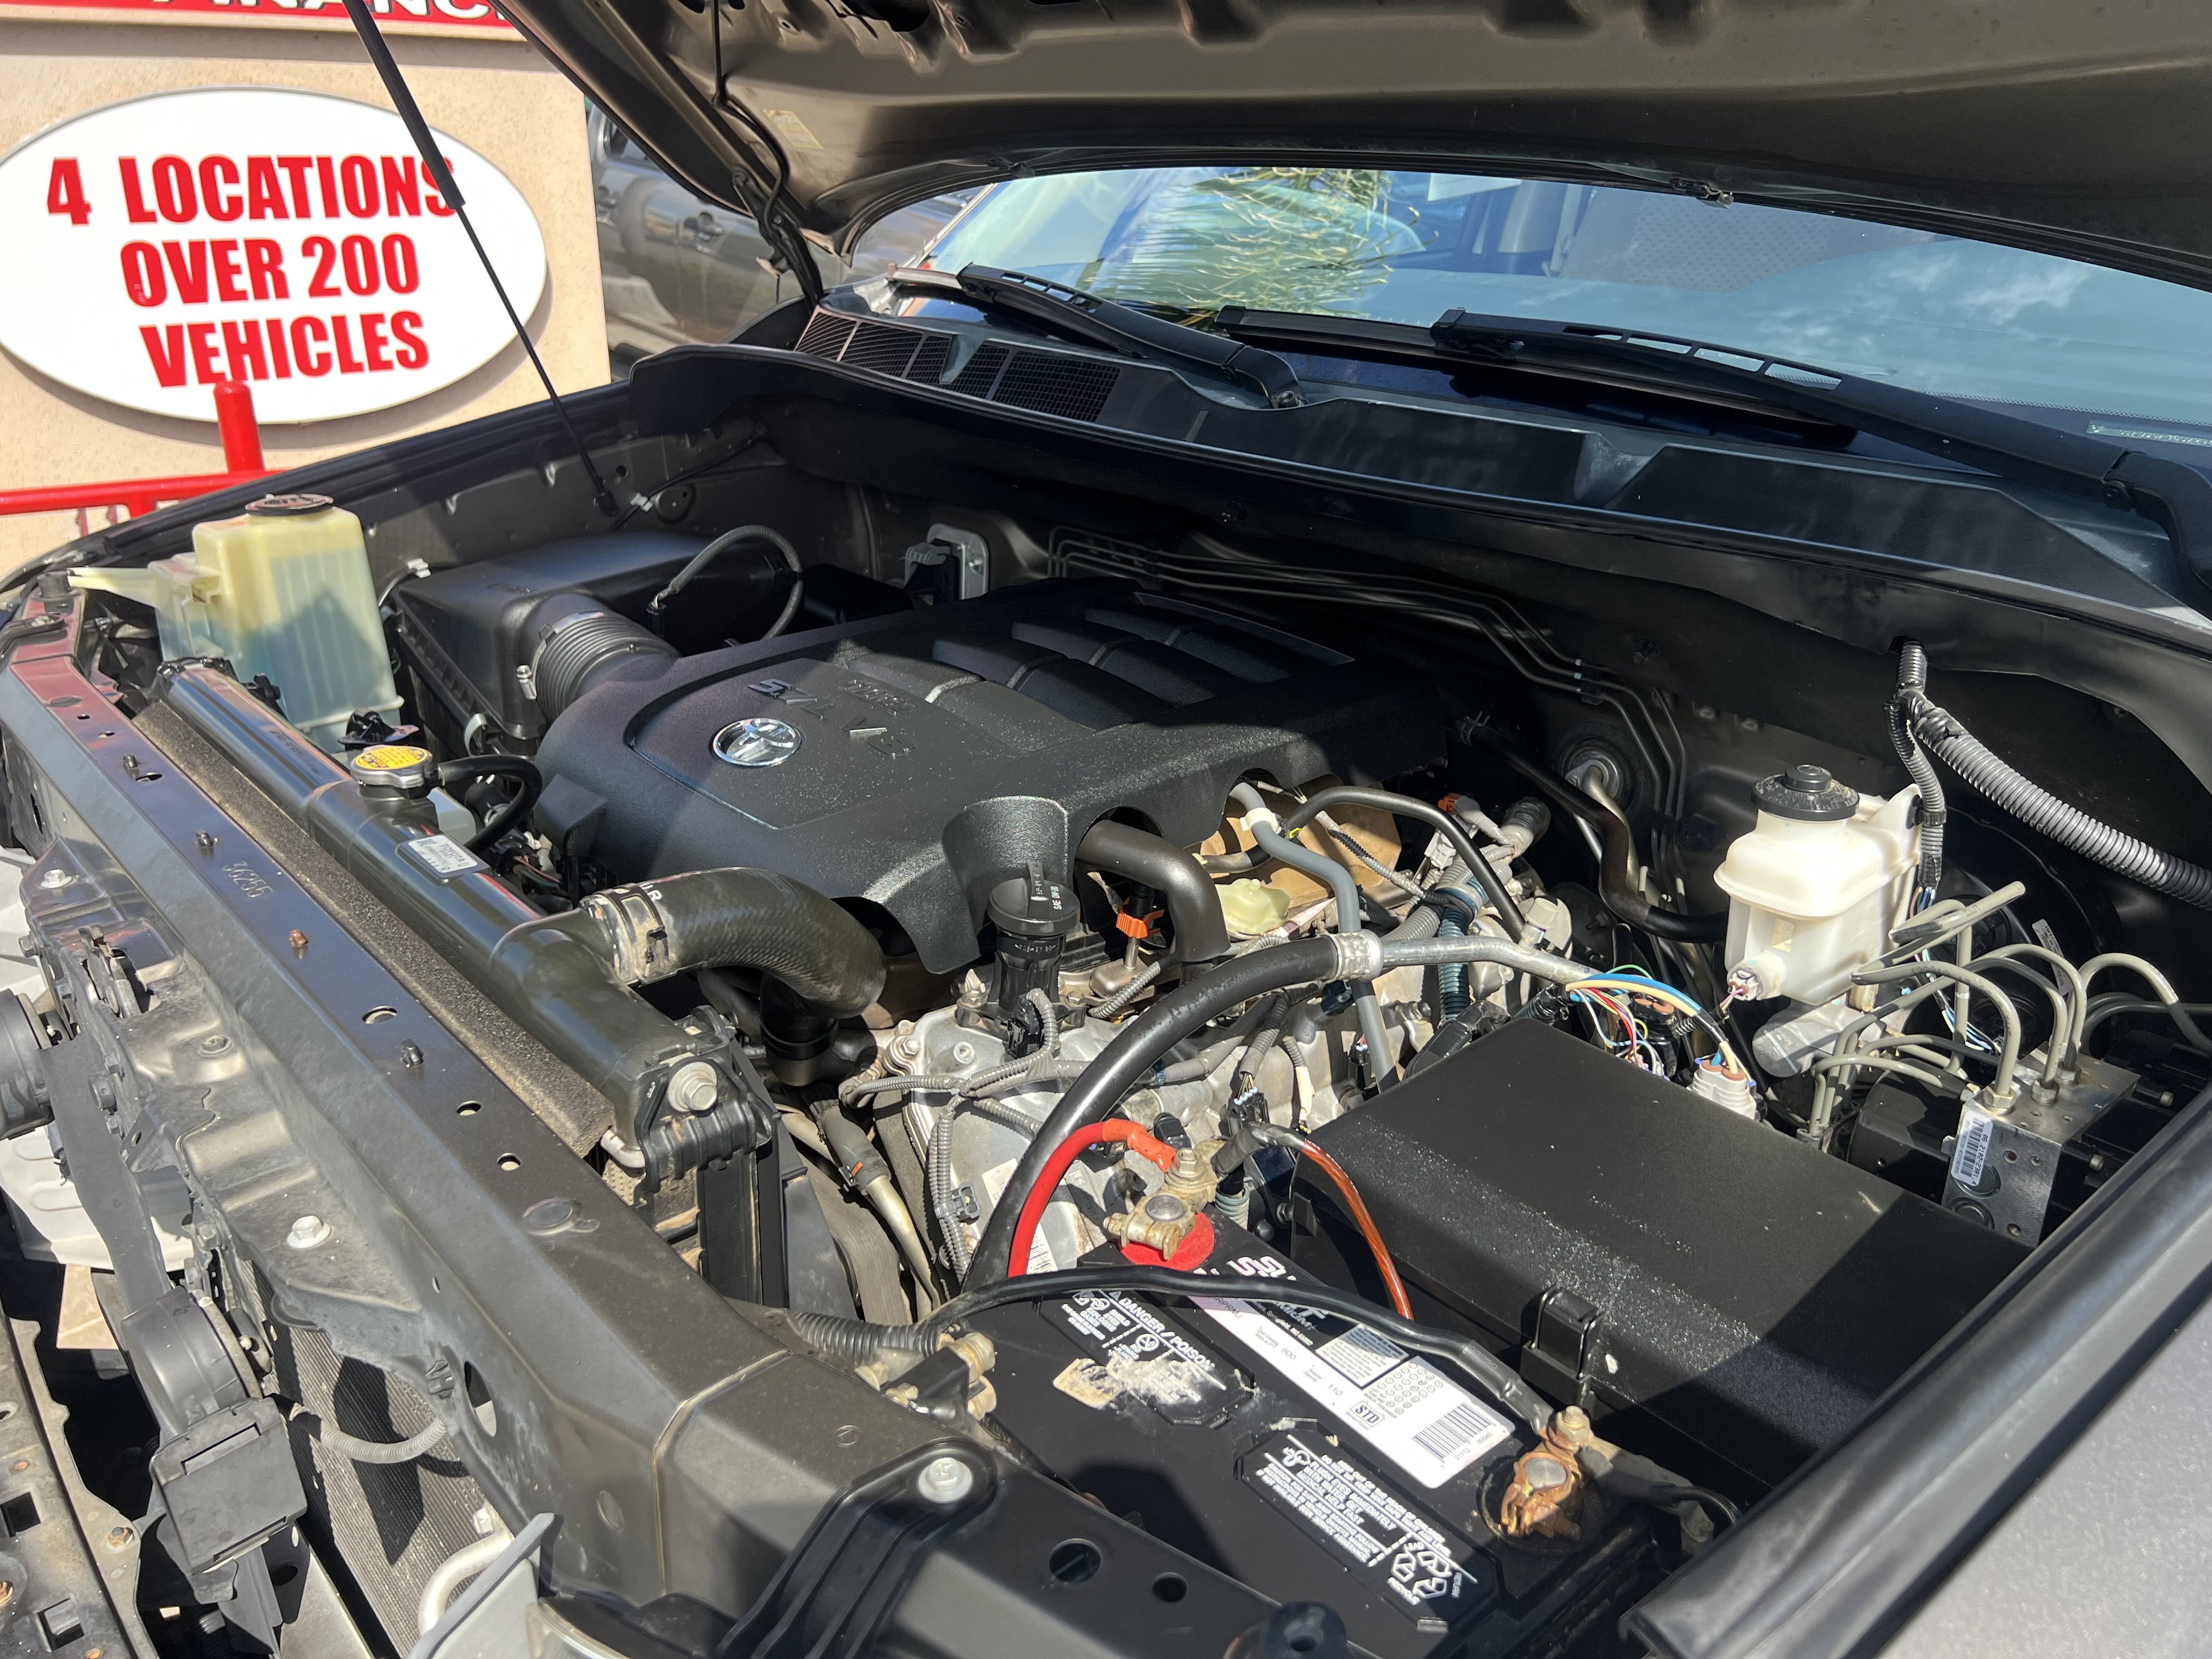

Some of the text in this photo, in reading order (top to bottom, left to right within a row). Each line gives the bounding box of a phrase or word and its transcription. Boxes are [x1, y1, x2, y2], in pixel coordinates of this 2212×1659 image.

[46, 155, 458, 226] 4 LOCATIONS
[120, 233, 420, 307] OVER 200
[139, 311, 430, 388] VEHICLES
[1080, 1310, 1101, 1327] GASES
[1086, 1307, 1117, 1331] EXPLOSIVE
[1103, 1313, 1120, 1326] EYES
[1109, 1309, 1131, 1327] SHIELD
[1119, 1297, 1166, 1333] DANGER
[1169, 1336, 1216, 1370] POISON
[1129, 1344, 1141, 1352] NO
[1280, 1347, 1296, 1359] 600
[1326, 1383, 1344, 1396] 110
[1354, 1405, 1380, 1424] STD
[1261, 1474, 1276, 1486] NOT
[1272, 1483, 1301, 1506] AVAILABLE
[1297, 1504, 1314, 1517] SEEK
[1311, 1515, 1335, 1535] SERVICE
[1262, 1467, 1300, 1497] INSTRUCTIONS
[1304, 1500, 1328, 1519] VEHICLE
[1295, 1471, 1364, 1525] MEDICAL HELP FAST
[1302, 1466, 1323, 1482] WITH
[1345, 1500, 1363, 1514] GET
[1308, 1462, 1396, 1531] FLUSH EYES IMMEDIATELY
[1320, 1455, 1333, 1464] DO
[1329, 1462, 1345, 1474] NOT
[1353, 1481, 1372, 1494] KEEP
[1369, 1493, 1386, 1506] VENT
[1384, 1504, 1403, 1519] CAPS
[1400, 1517, 1420, 1532] TIGHT
[1417, 1530, 1434, 1542] AND
[1351, 1471, 1366, 1482] OUT
[1373, 1488, 1388, 1499] THE
[1385, 1497, 1407, 1514] REACH
[1290, 1481, 1304, 1492] FOR
[1301, 1491, 1317, 1502] SAFE
[1314, 1502, 1331, 1515] JUMP
[1329, 1513, 1356, 1534] STARTING
[1355, 1533, 1380, 1553] FOLLOW
[1385, 1577, 1421, 1605] RECYCLE
